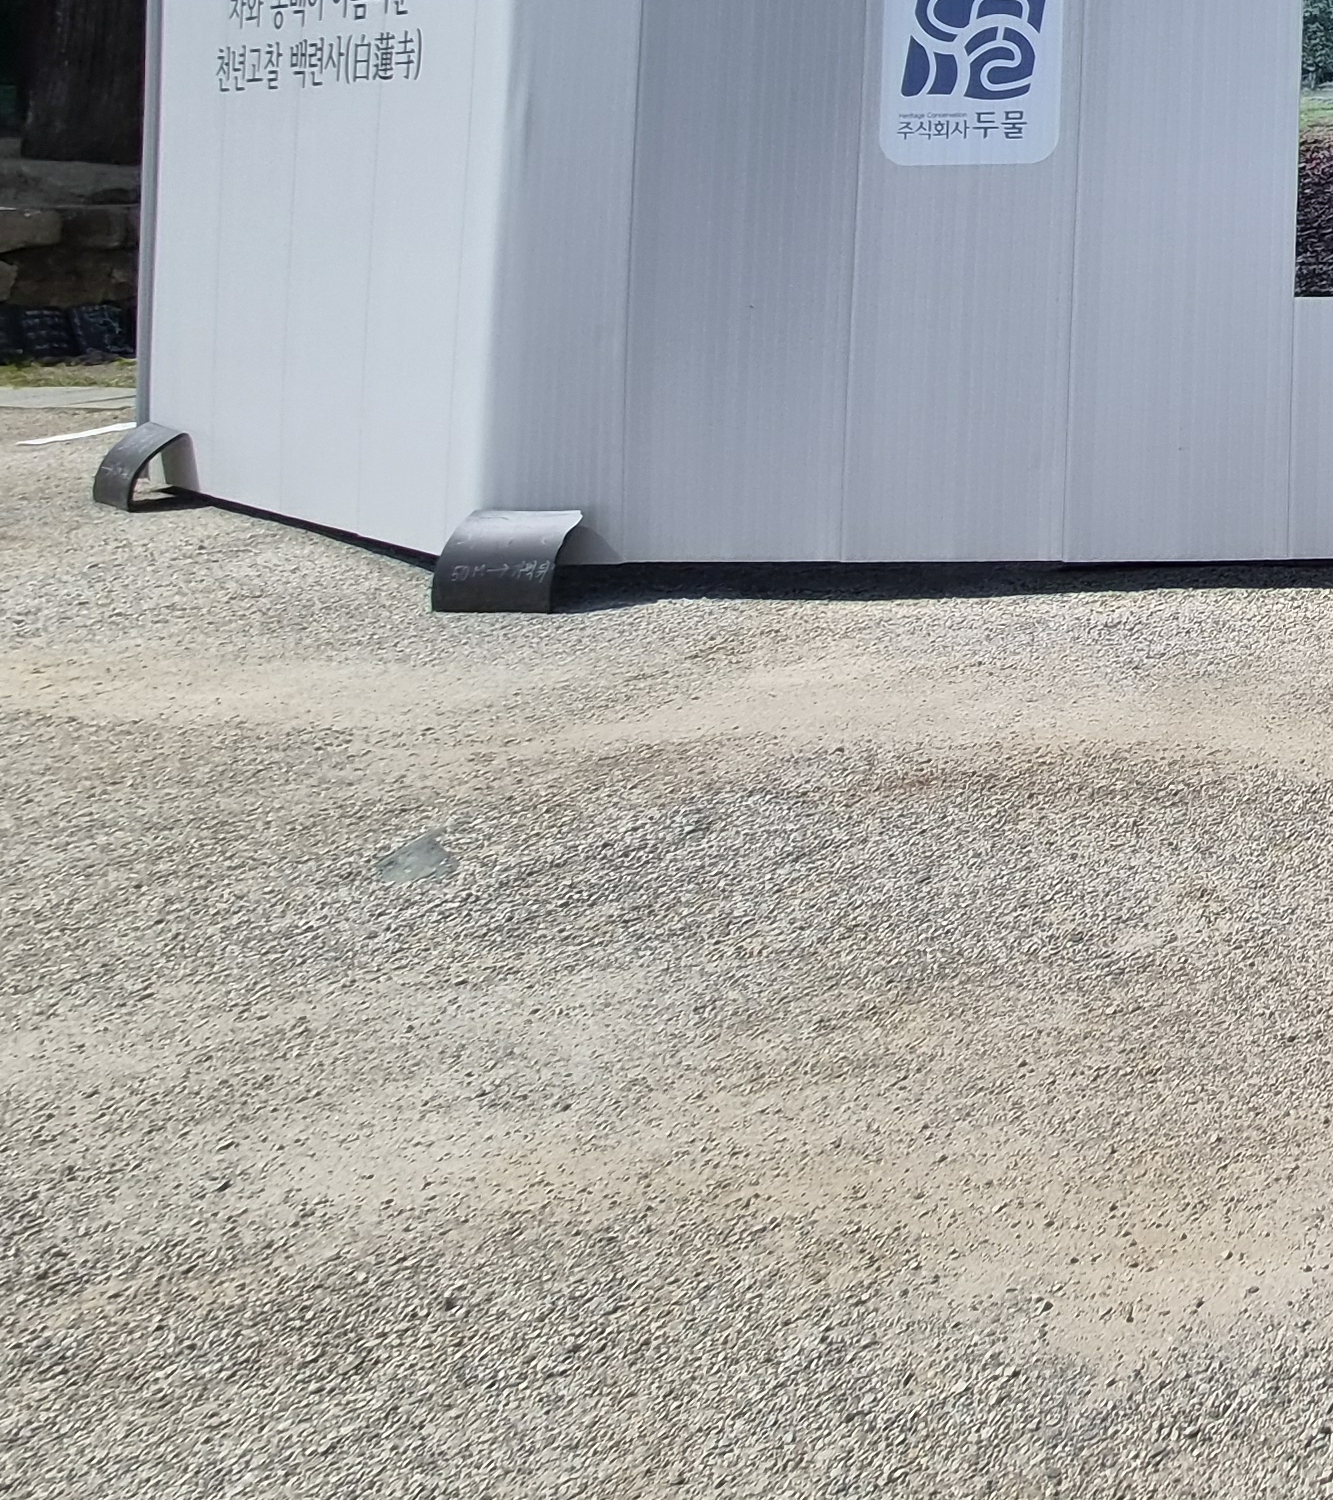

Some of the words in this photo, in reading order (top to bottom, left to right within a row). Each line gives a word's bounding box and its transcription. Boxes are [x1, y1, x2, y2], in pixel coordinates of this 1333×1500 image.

[216, 41, 284, 92] 천년고찰
[289, 28, 423, 89] 백련사(白蓮寺)
[896, 119, 970, 140] 주식회사
[972, 110, 1028, 140] 두물
